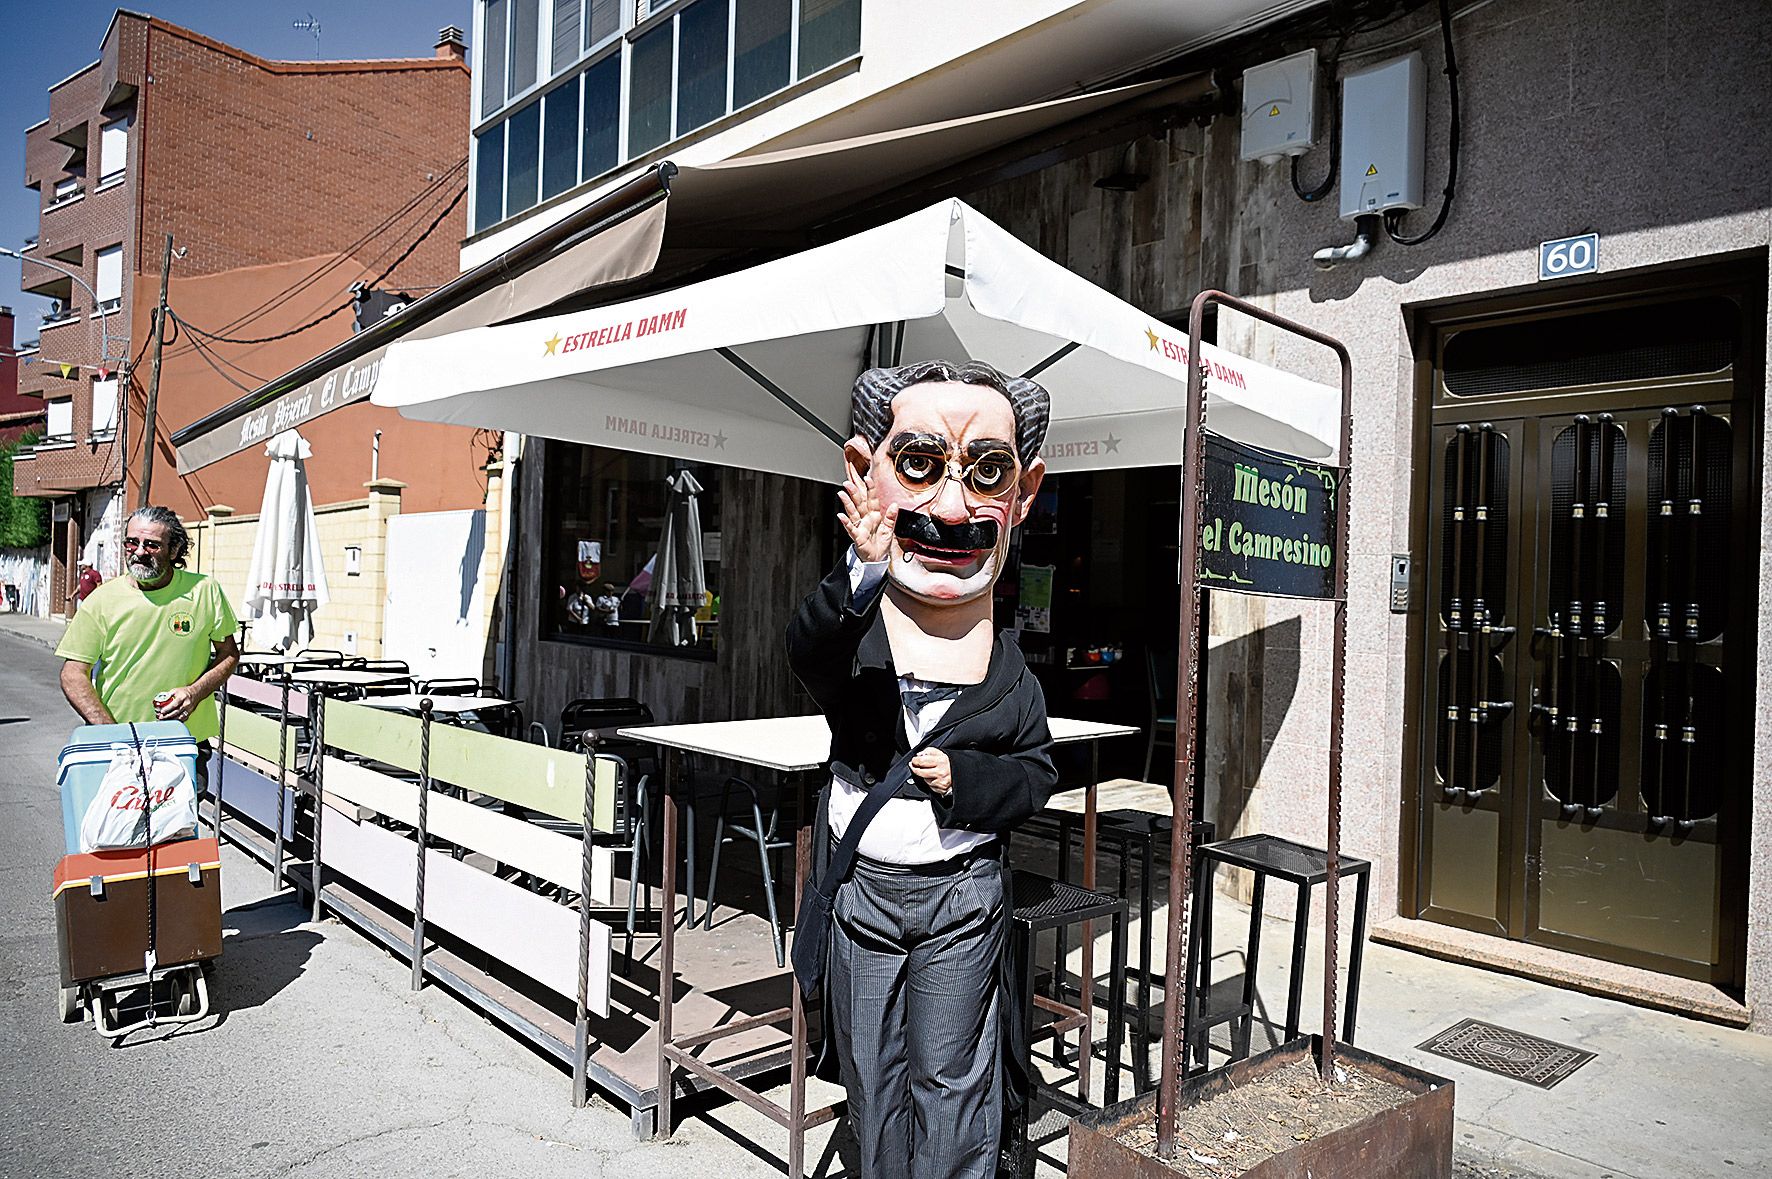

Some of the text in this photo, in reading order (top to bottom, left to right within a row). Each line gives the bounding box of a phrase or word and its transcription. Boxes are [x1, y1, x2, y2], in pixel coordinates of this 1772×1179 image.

[1546, 240, 1591, 273] 60
[562, 308, 687, 354] ESTRELLA DAMM
[320, 373, 337, 408] El
[1214, 362, 1247, 390] DAMM
[1233, 462, 1307, 514] Mesón
[1202, 517, 1332, 568] el Campesino
